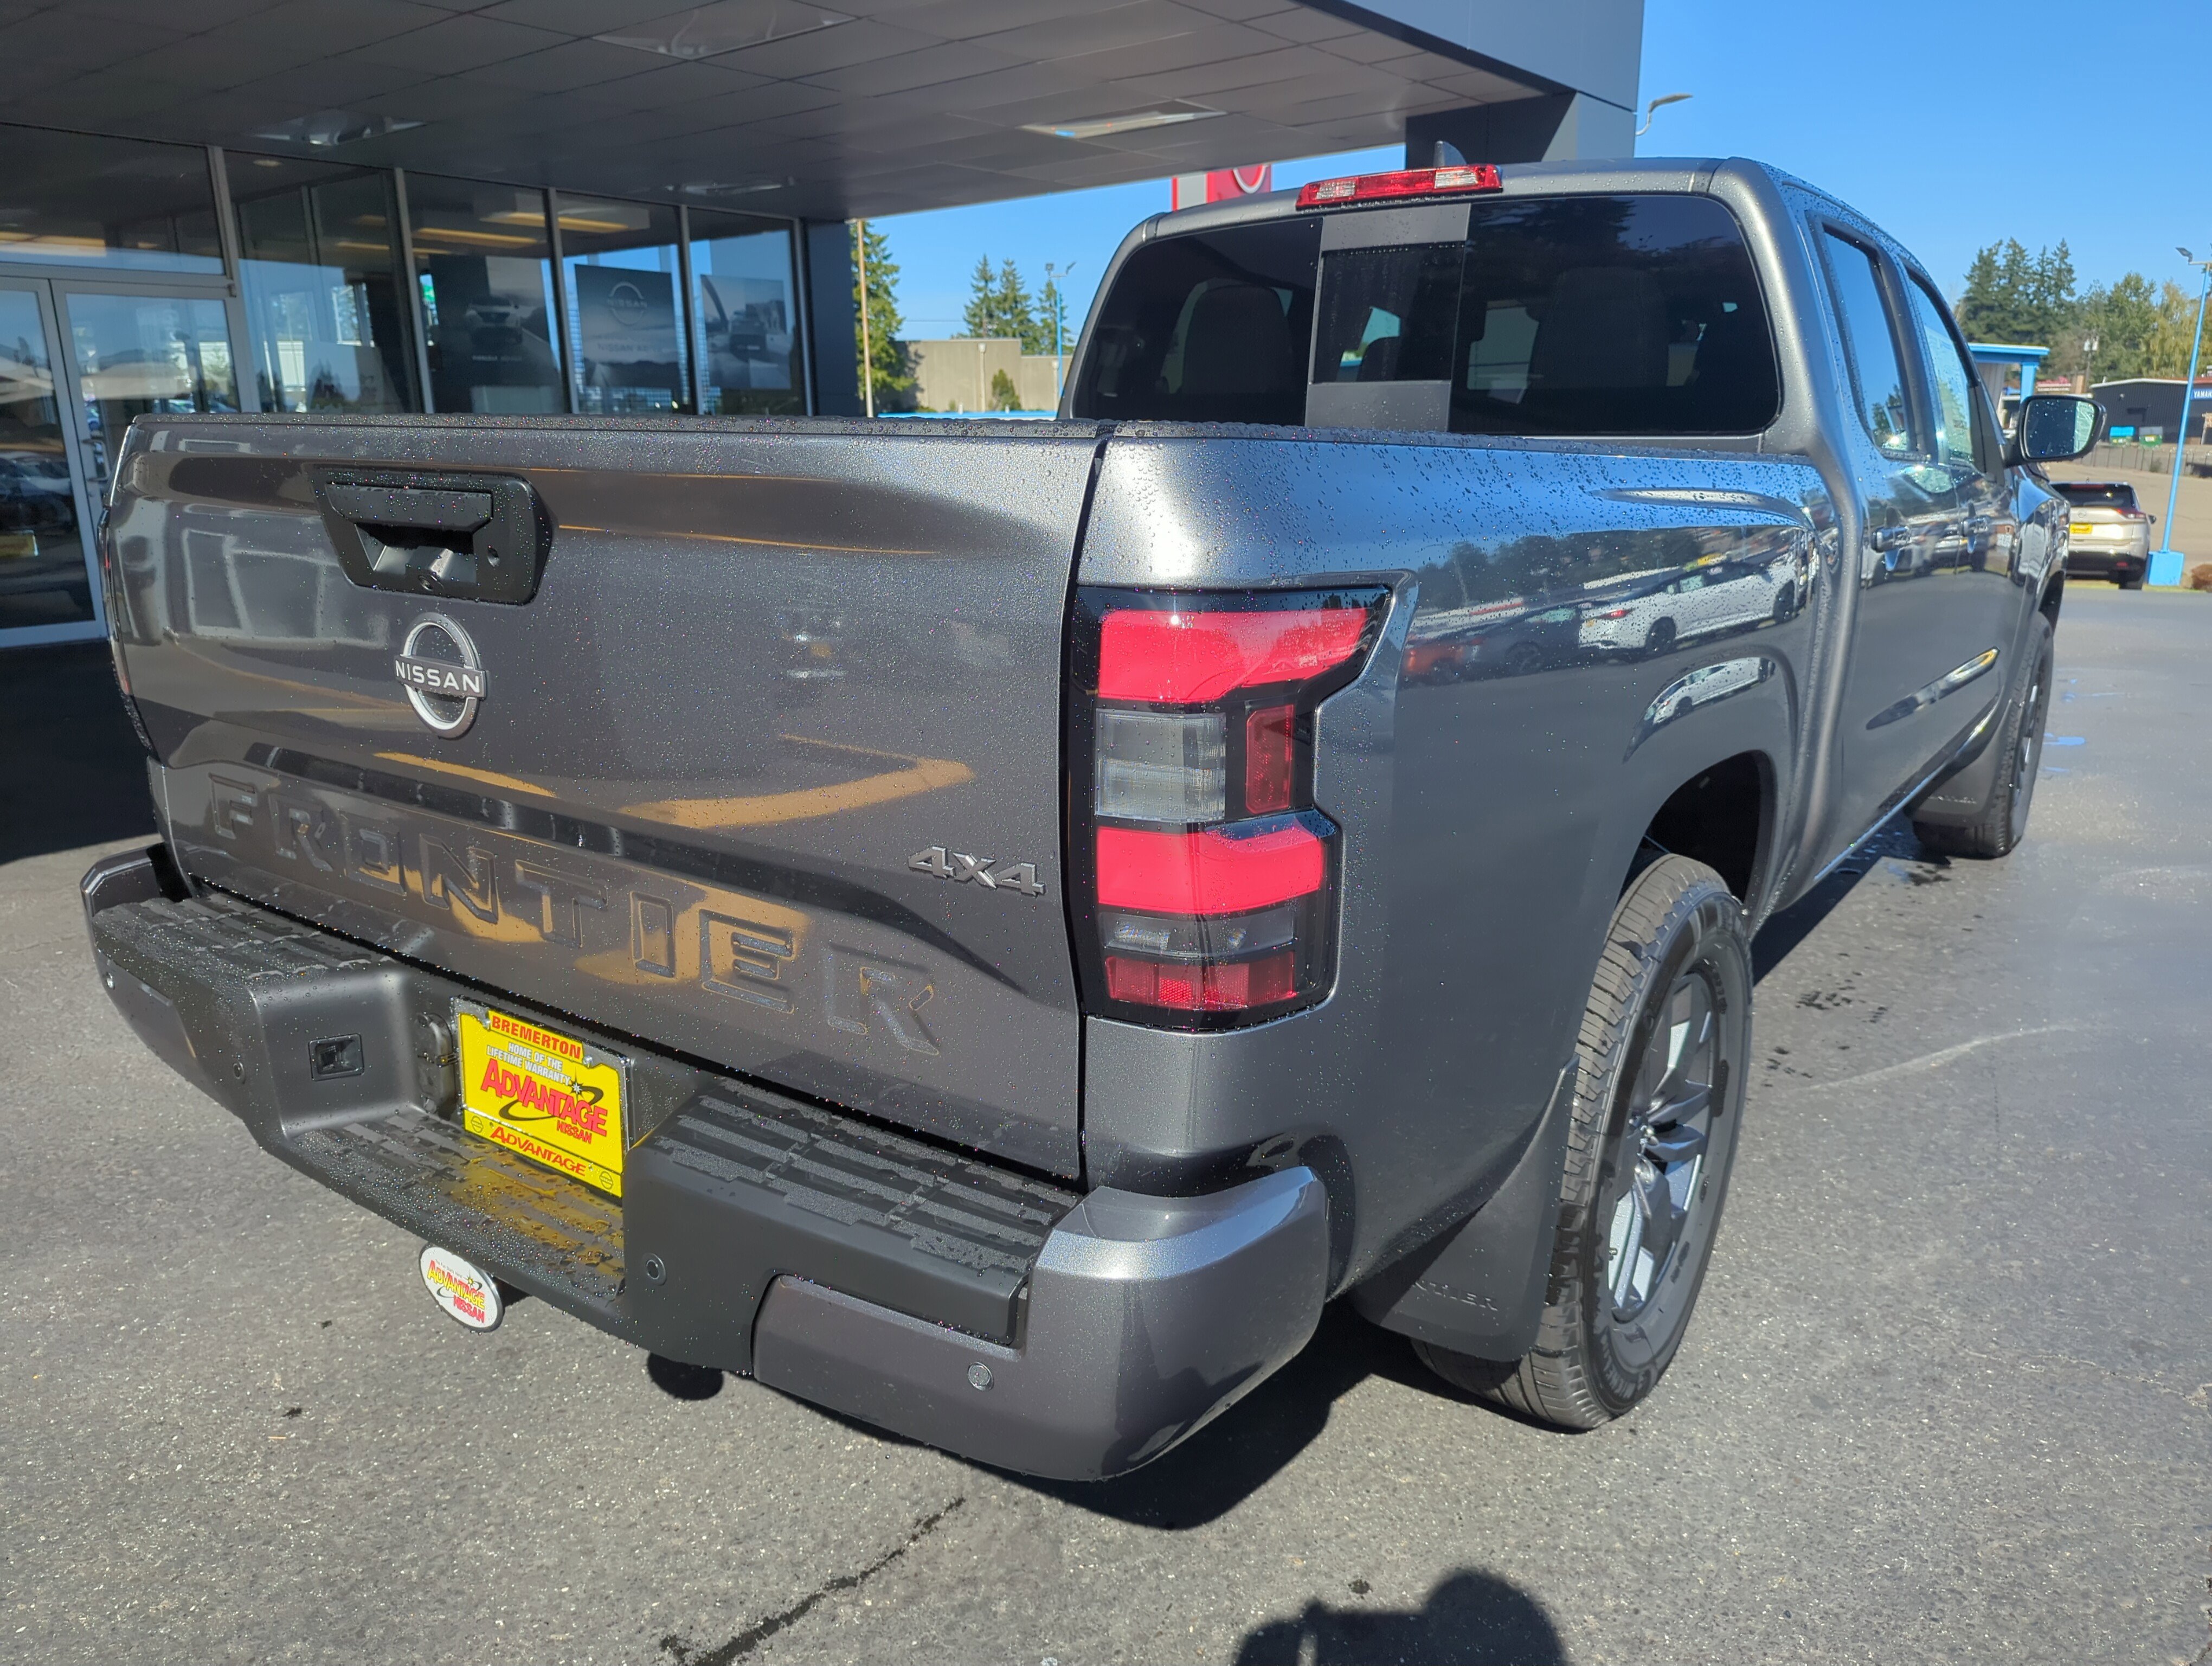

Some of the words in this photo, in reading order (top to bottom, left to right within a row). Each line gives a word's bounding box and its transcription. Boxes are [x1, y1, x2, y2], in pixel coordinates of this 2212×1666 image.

[2194, 390, 2212, 399] YAMAH
[395, 660, 480, 693] NISSAN
[208, 772, 940, 1056] FRONTIER
[491, 1015, 581, 1059] BREMERTON
[508, 1042, 532, 1060] HOME
[533, 1050, 545, 1063] OF
[547, 1054, 563, 1072] THE
[486, 1045, 523, 1068] LIFETIME
[524, 1060, 571, 1086] WARRANTY
[481, 1059, 608, 1136] ADVANTAGE
[490, 1126, 587, 1177] ADVANTAGE
[556, 1120, 593, 1144] NISSAN
[427, 1259, 485, 1310] ADVANTAGE
[453, 1295, 485, 1323] NISSAN
